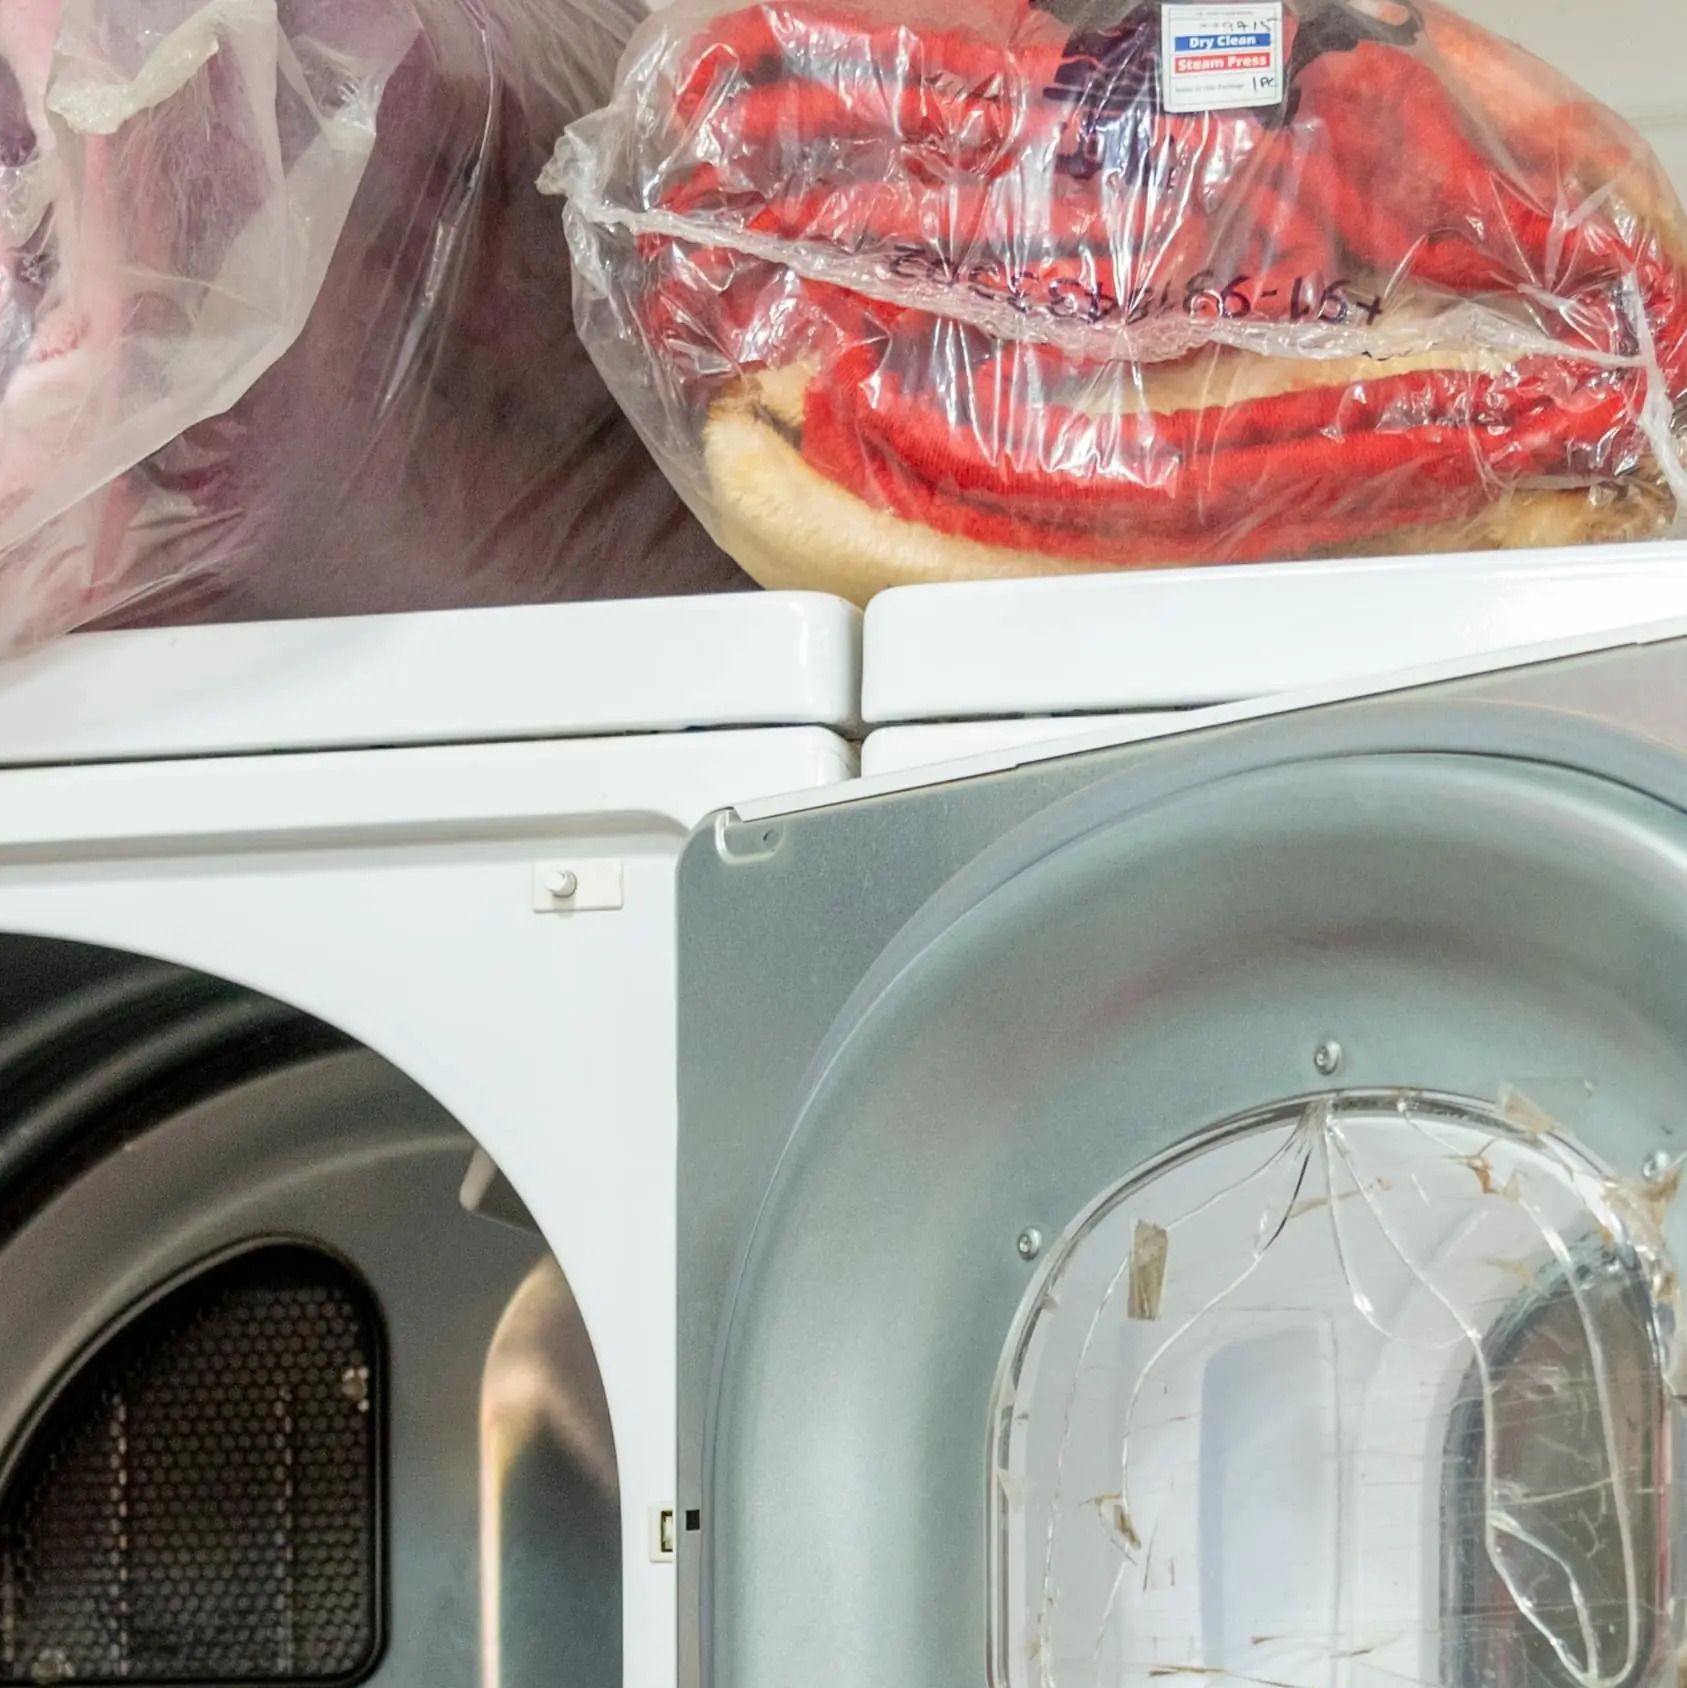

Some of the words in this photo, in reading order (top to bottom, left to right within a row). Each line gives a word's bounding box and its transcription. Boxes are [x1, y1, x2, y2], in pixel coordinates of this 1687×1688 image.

[1189, 37, 1215, 50] Dry
[1217, 35, 1257, 47] Clean
[1178, 57, 1224, 71] Steam
[1227, 56, 1267, 68] Press
